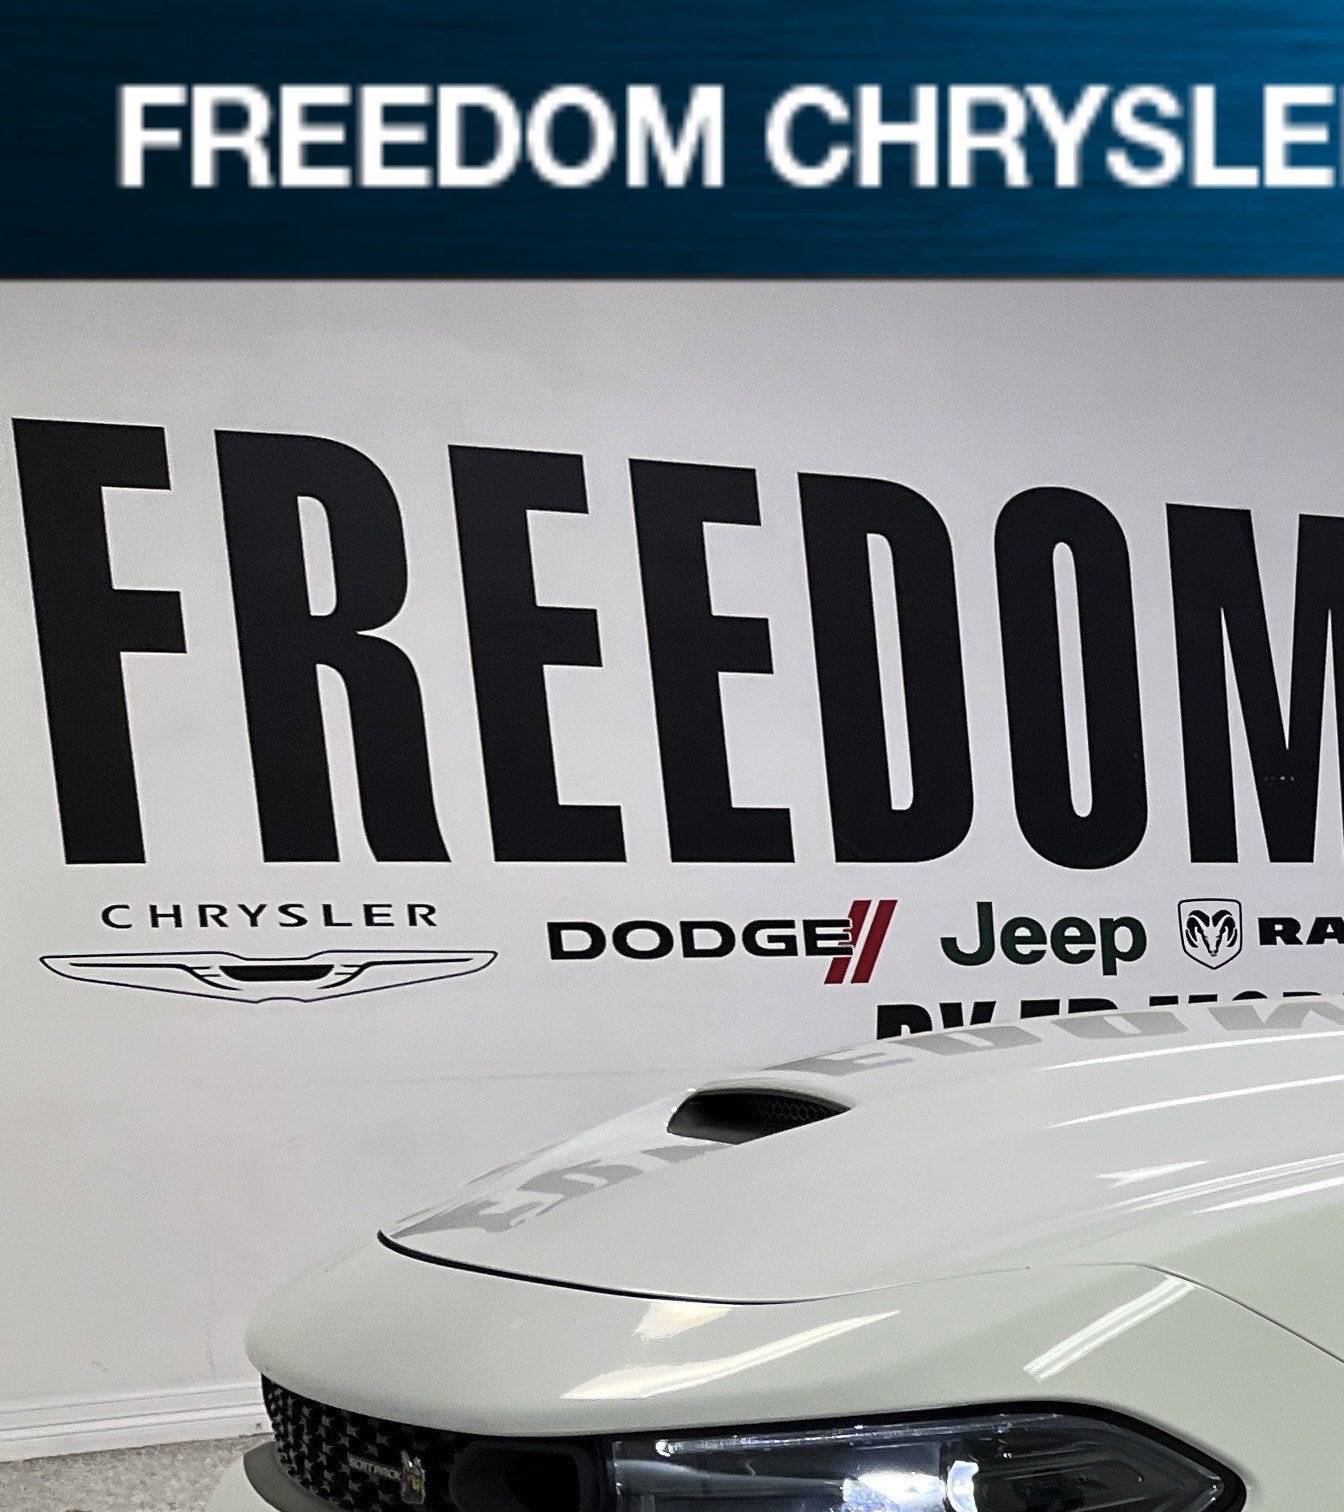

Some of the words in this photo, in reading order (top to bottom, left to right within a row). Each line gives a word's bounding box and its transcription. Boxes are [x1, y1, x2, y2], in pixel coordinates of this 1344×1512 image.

[101, 903, 437, 929] CHRYSLER
[547, 918, 854, 960] DODGE
[941, 902, 1148, 976] Jeep
